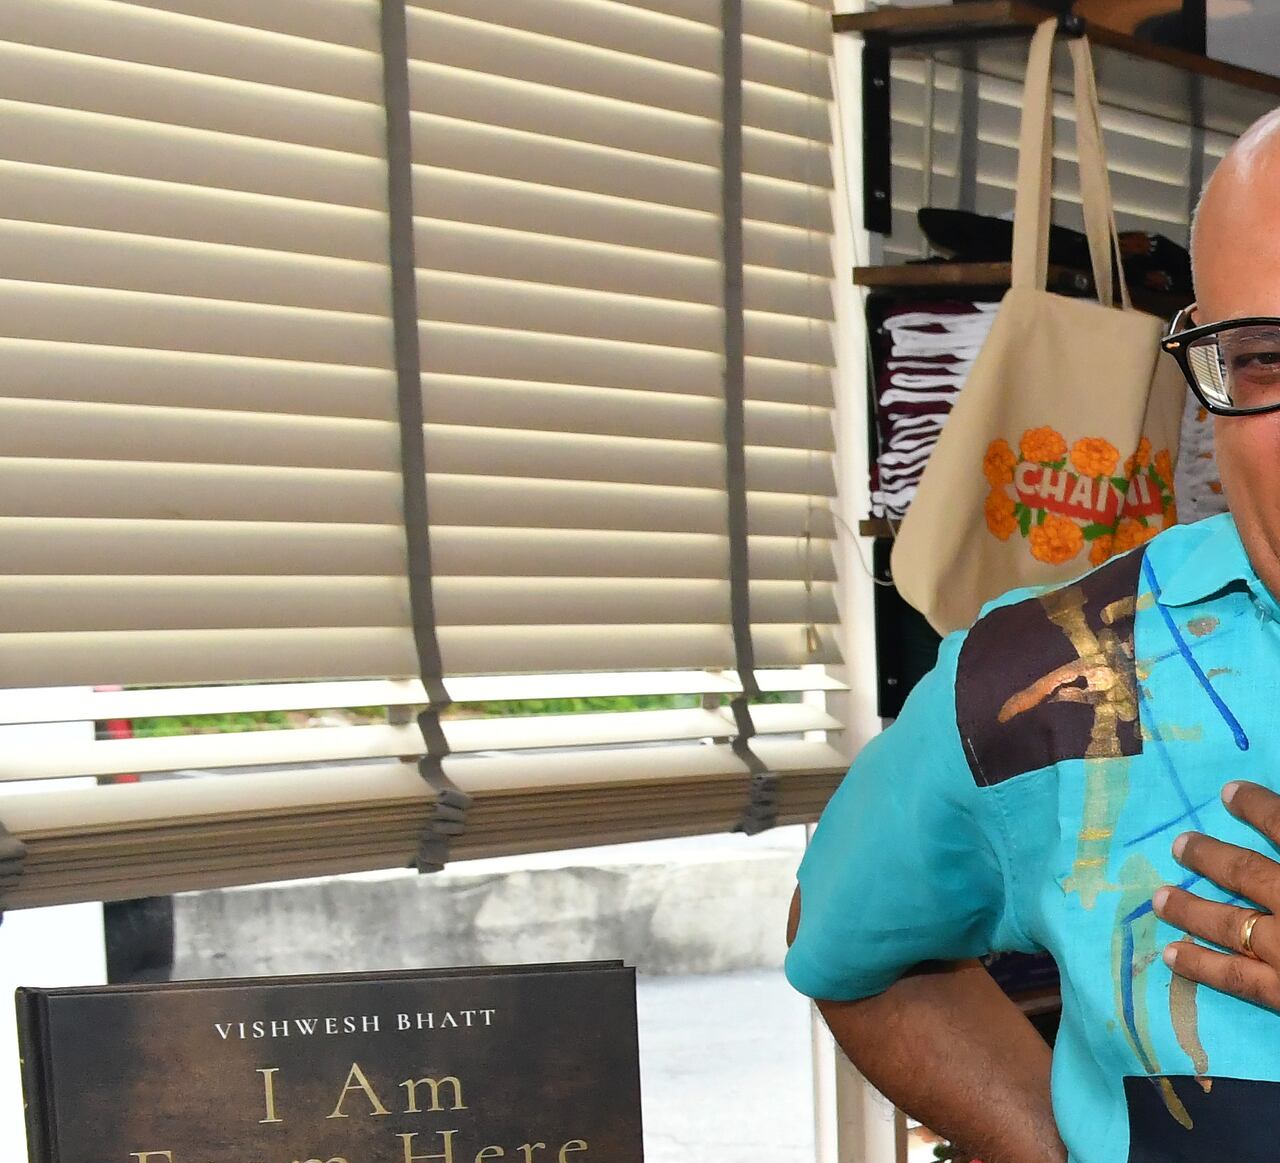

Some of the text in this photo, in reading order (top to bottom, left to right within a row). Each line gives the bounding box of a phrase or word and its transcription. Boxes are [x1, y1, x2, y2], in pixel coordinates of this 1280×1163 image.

[1015, 461, 1109, 512] CHAI
[214, 1009, 496, 1040] VISHWESH BHATT
[255, 1062, 468, 1124] I Am
